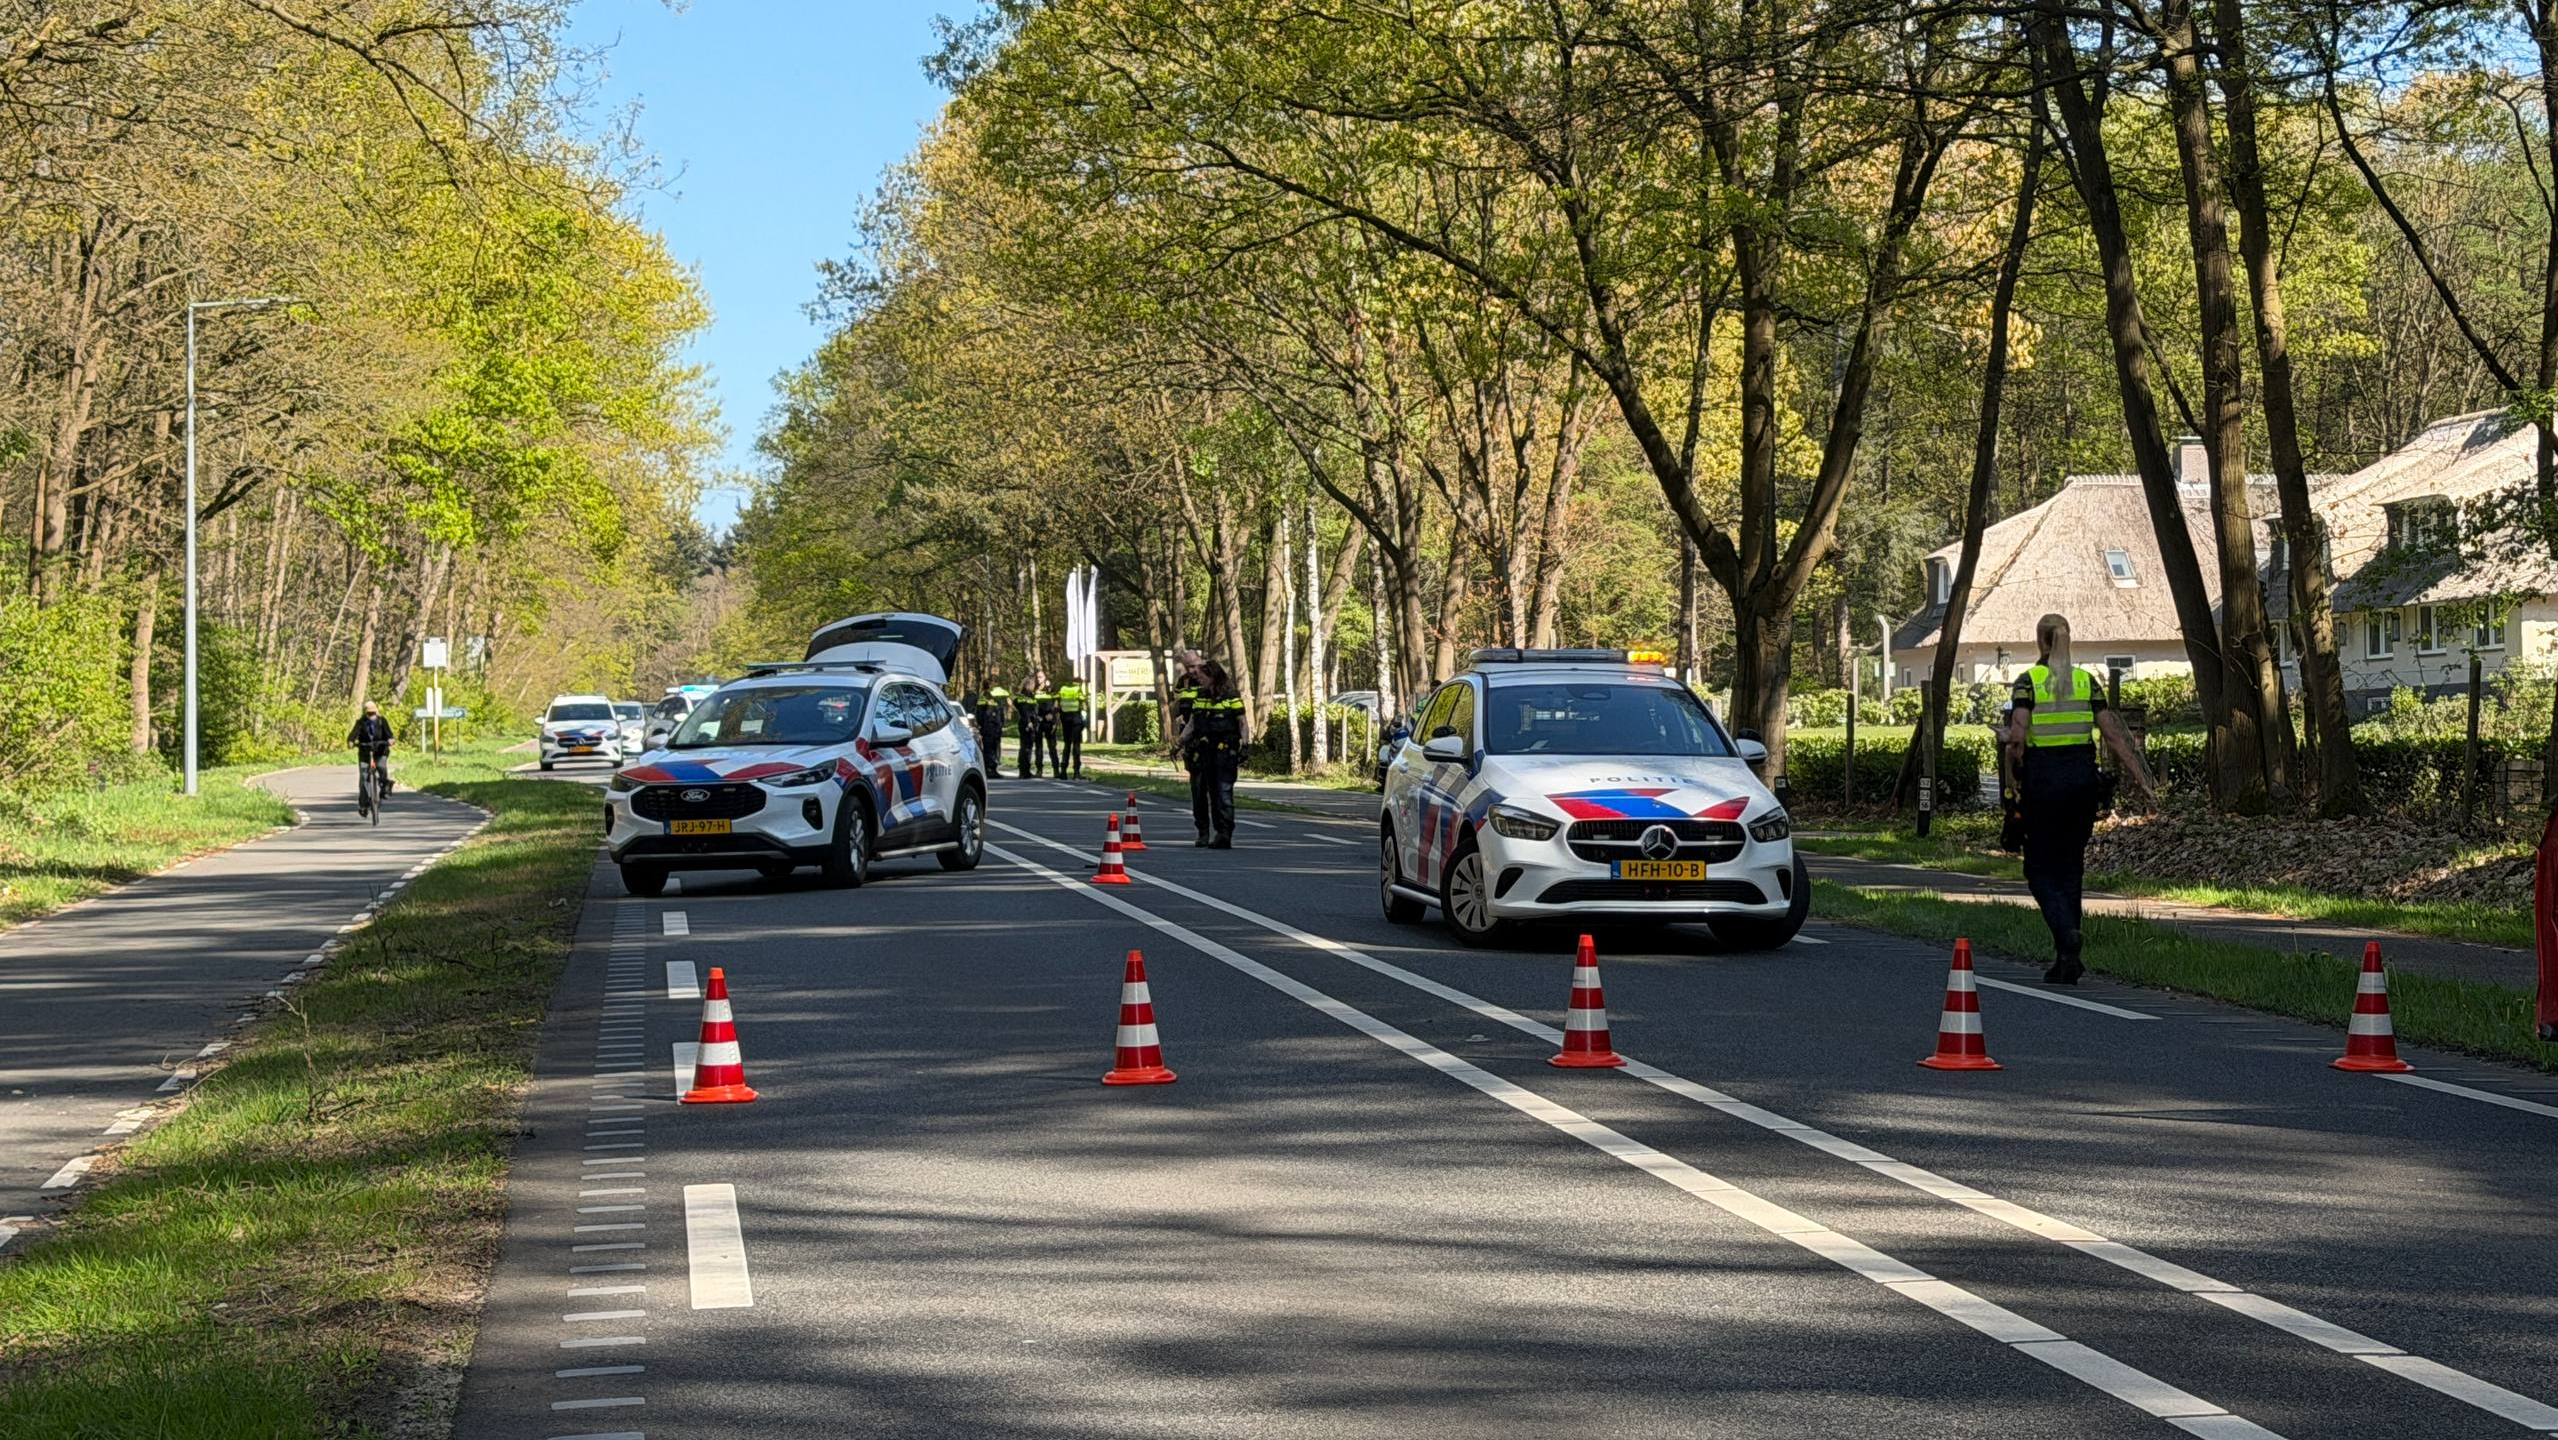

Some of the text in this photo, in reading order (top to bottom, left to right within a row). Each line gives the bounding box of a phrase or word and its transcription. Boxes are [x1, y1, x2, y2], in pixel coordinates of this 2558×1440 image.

[1589, 776, 1693, 784] POLITIE
[674, 821, 726, 833] JRJ-97-H
[1628, 863, 1700, 877] HFH-10-B
